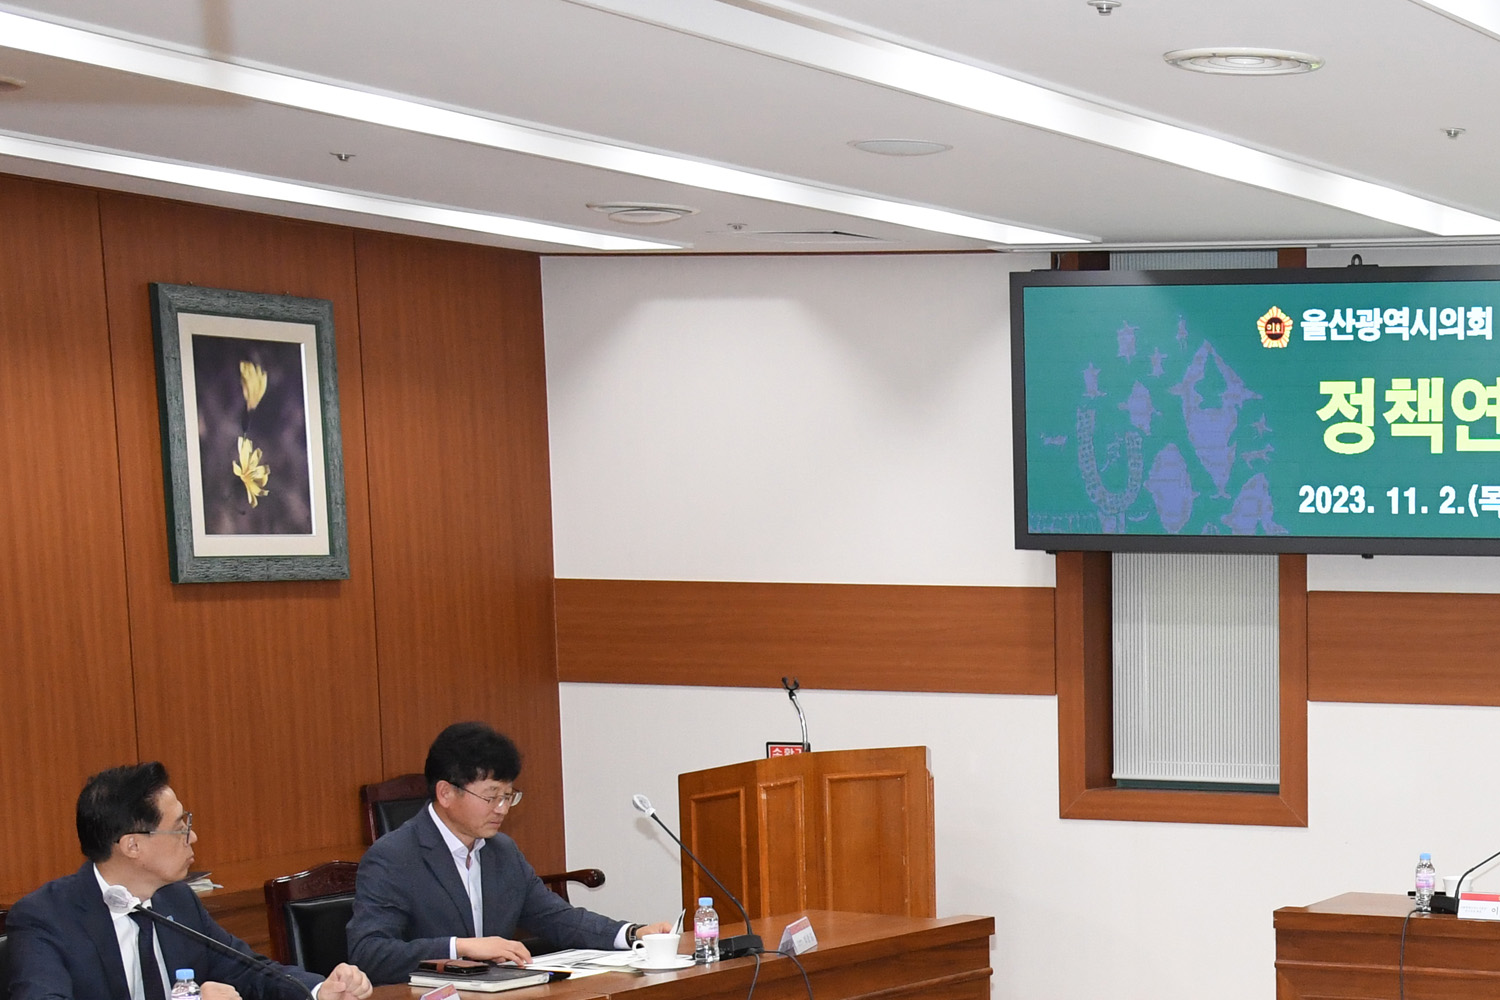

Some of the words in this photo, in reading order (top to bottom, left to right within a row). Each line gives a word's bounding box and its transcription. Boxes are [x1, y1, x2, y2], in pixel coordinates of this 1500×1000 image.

[1300, 306, 1493, 341] 울산광역시의회
[1298, 485, 1375, 514] 2023.
[1386, 486, 1428, 515] 11.
